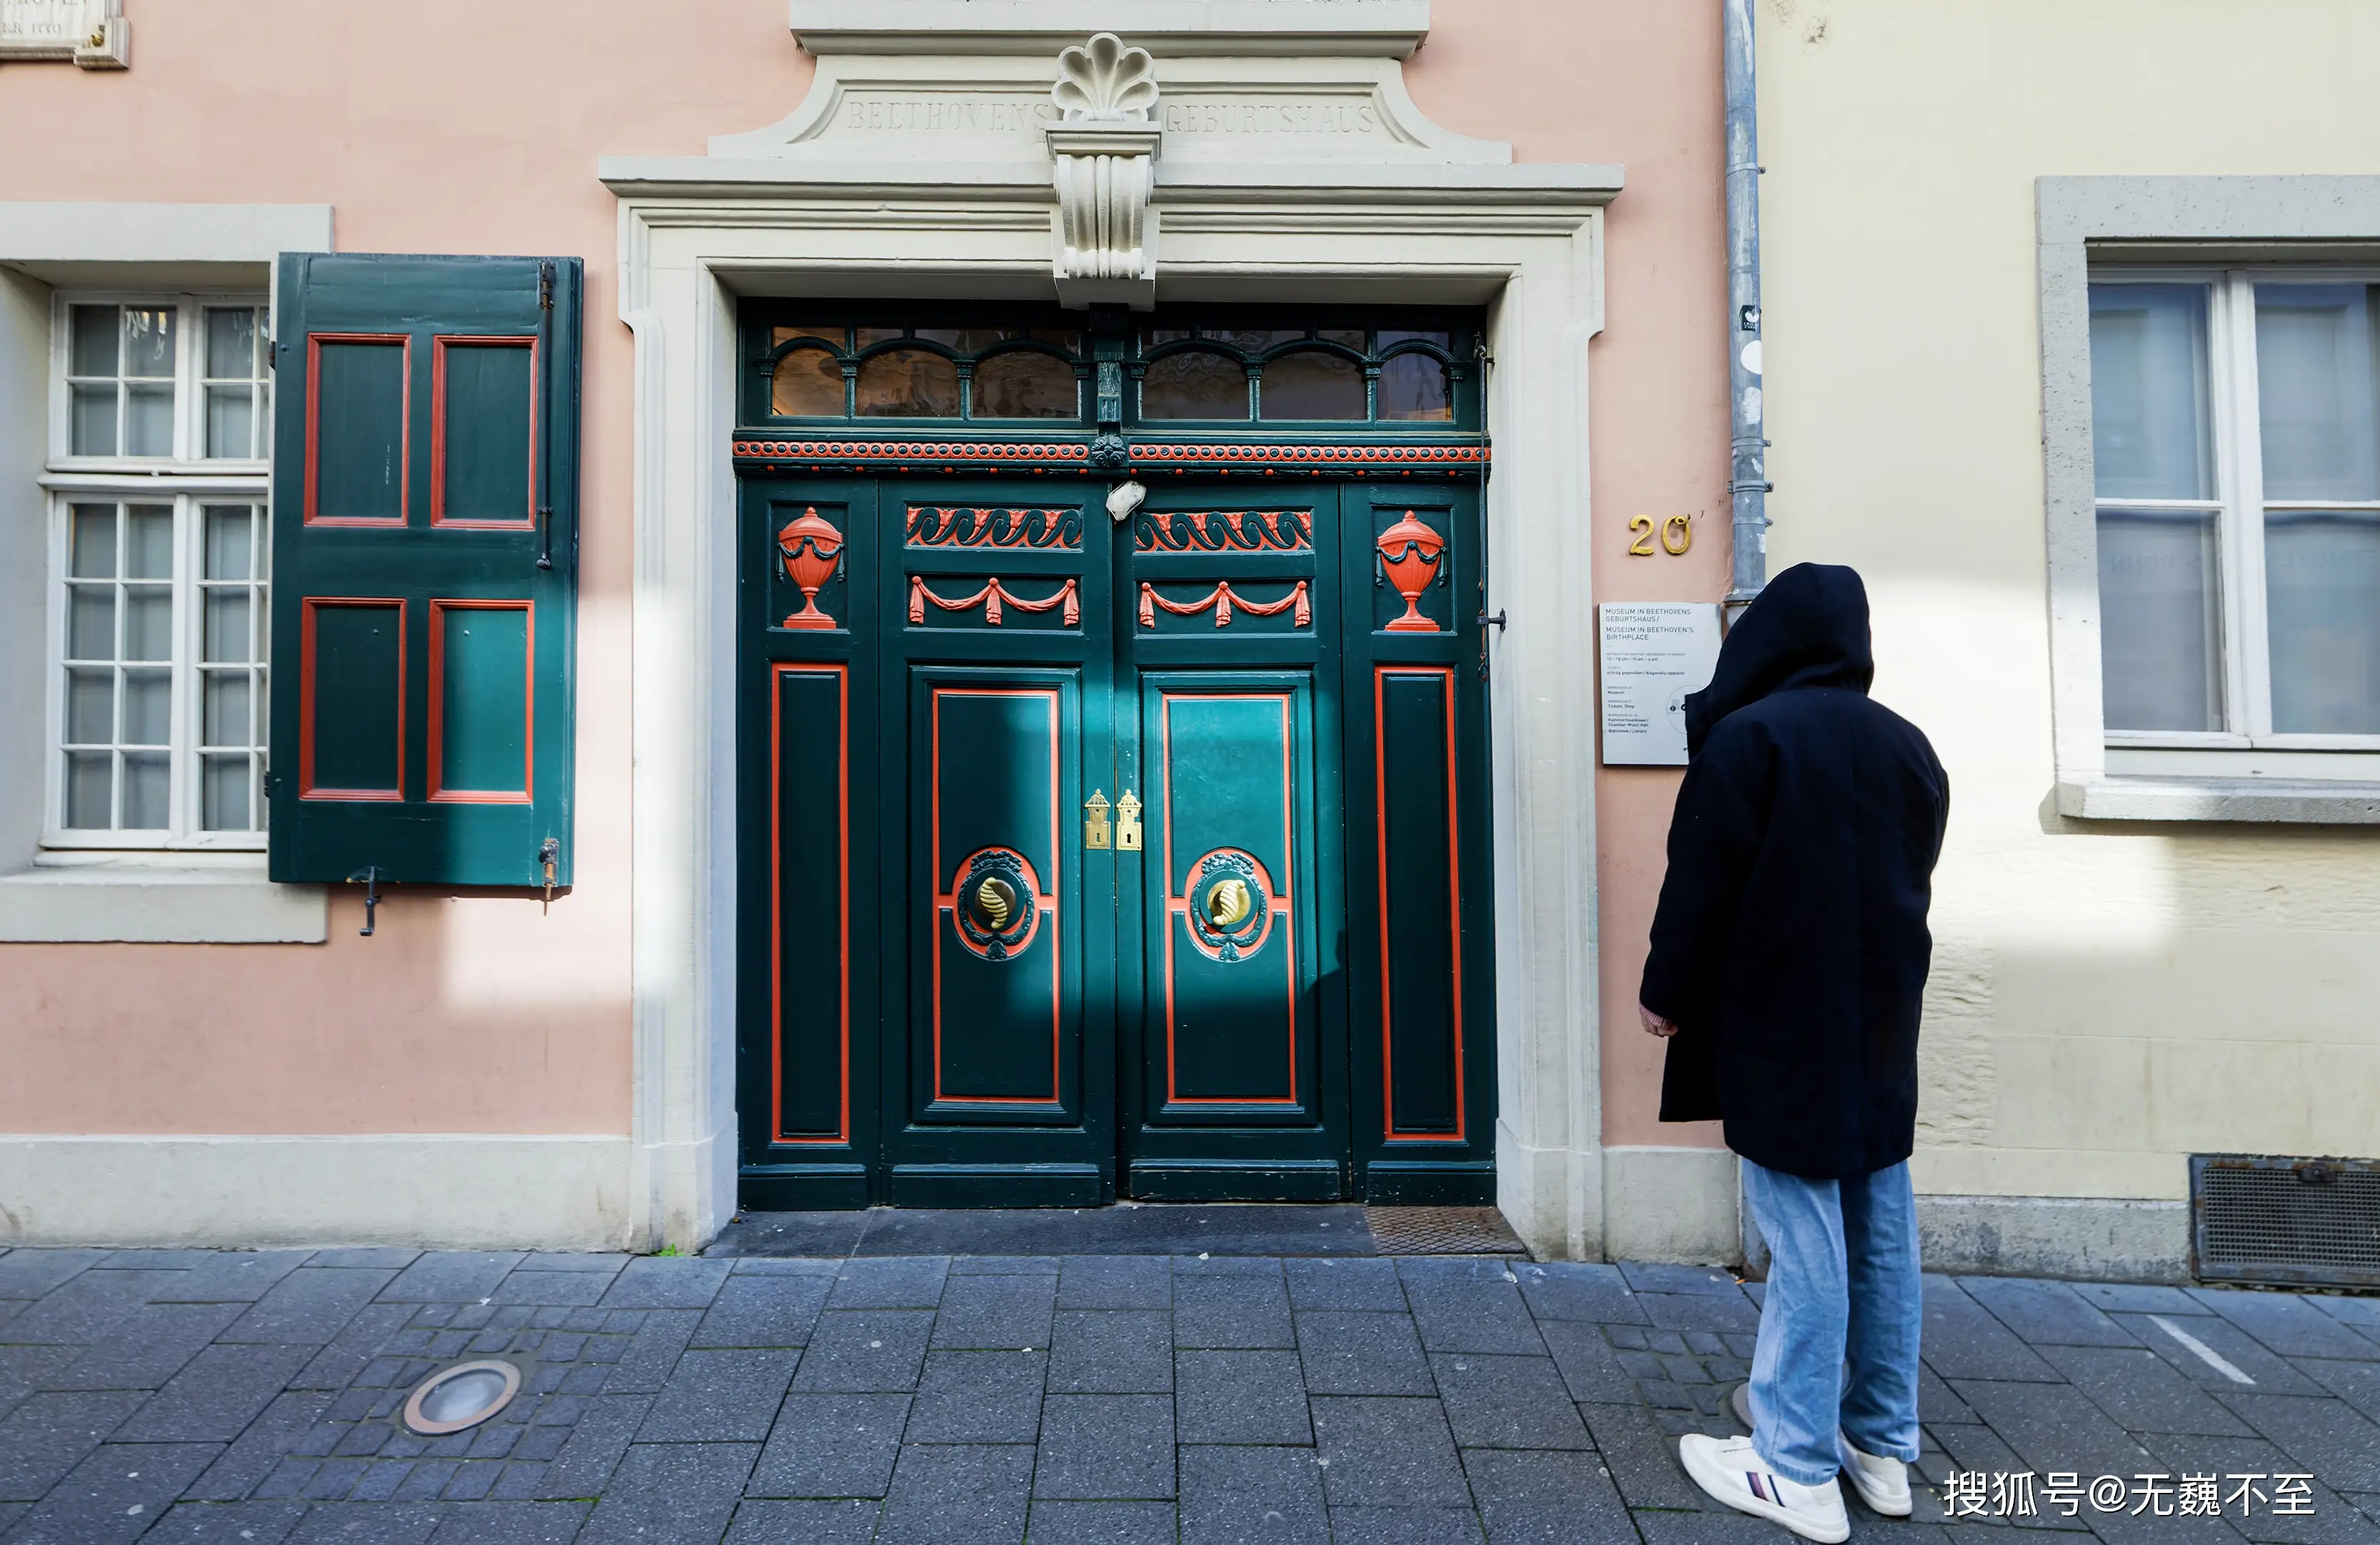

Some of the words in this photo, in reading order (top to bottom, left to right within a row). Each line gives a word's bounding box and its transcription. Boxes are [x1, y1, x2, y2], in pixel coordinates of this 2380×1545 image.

[846, 101, 1049, 131] BEETHOVENS
[1165, 104, 1374, 133] GEBURTSHAUS
[1630, 514, 1690, 556] 20
